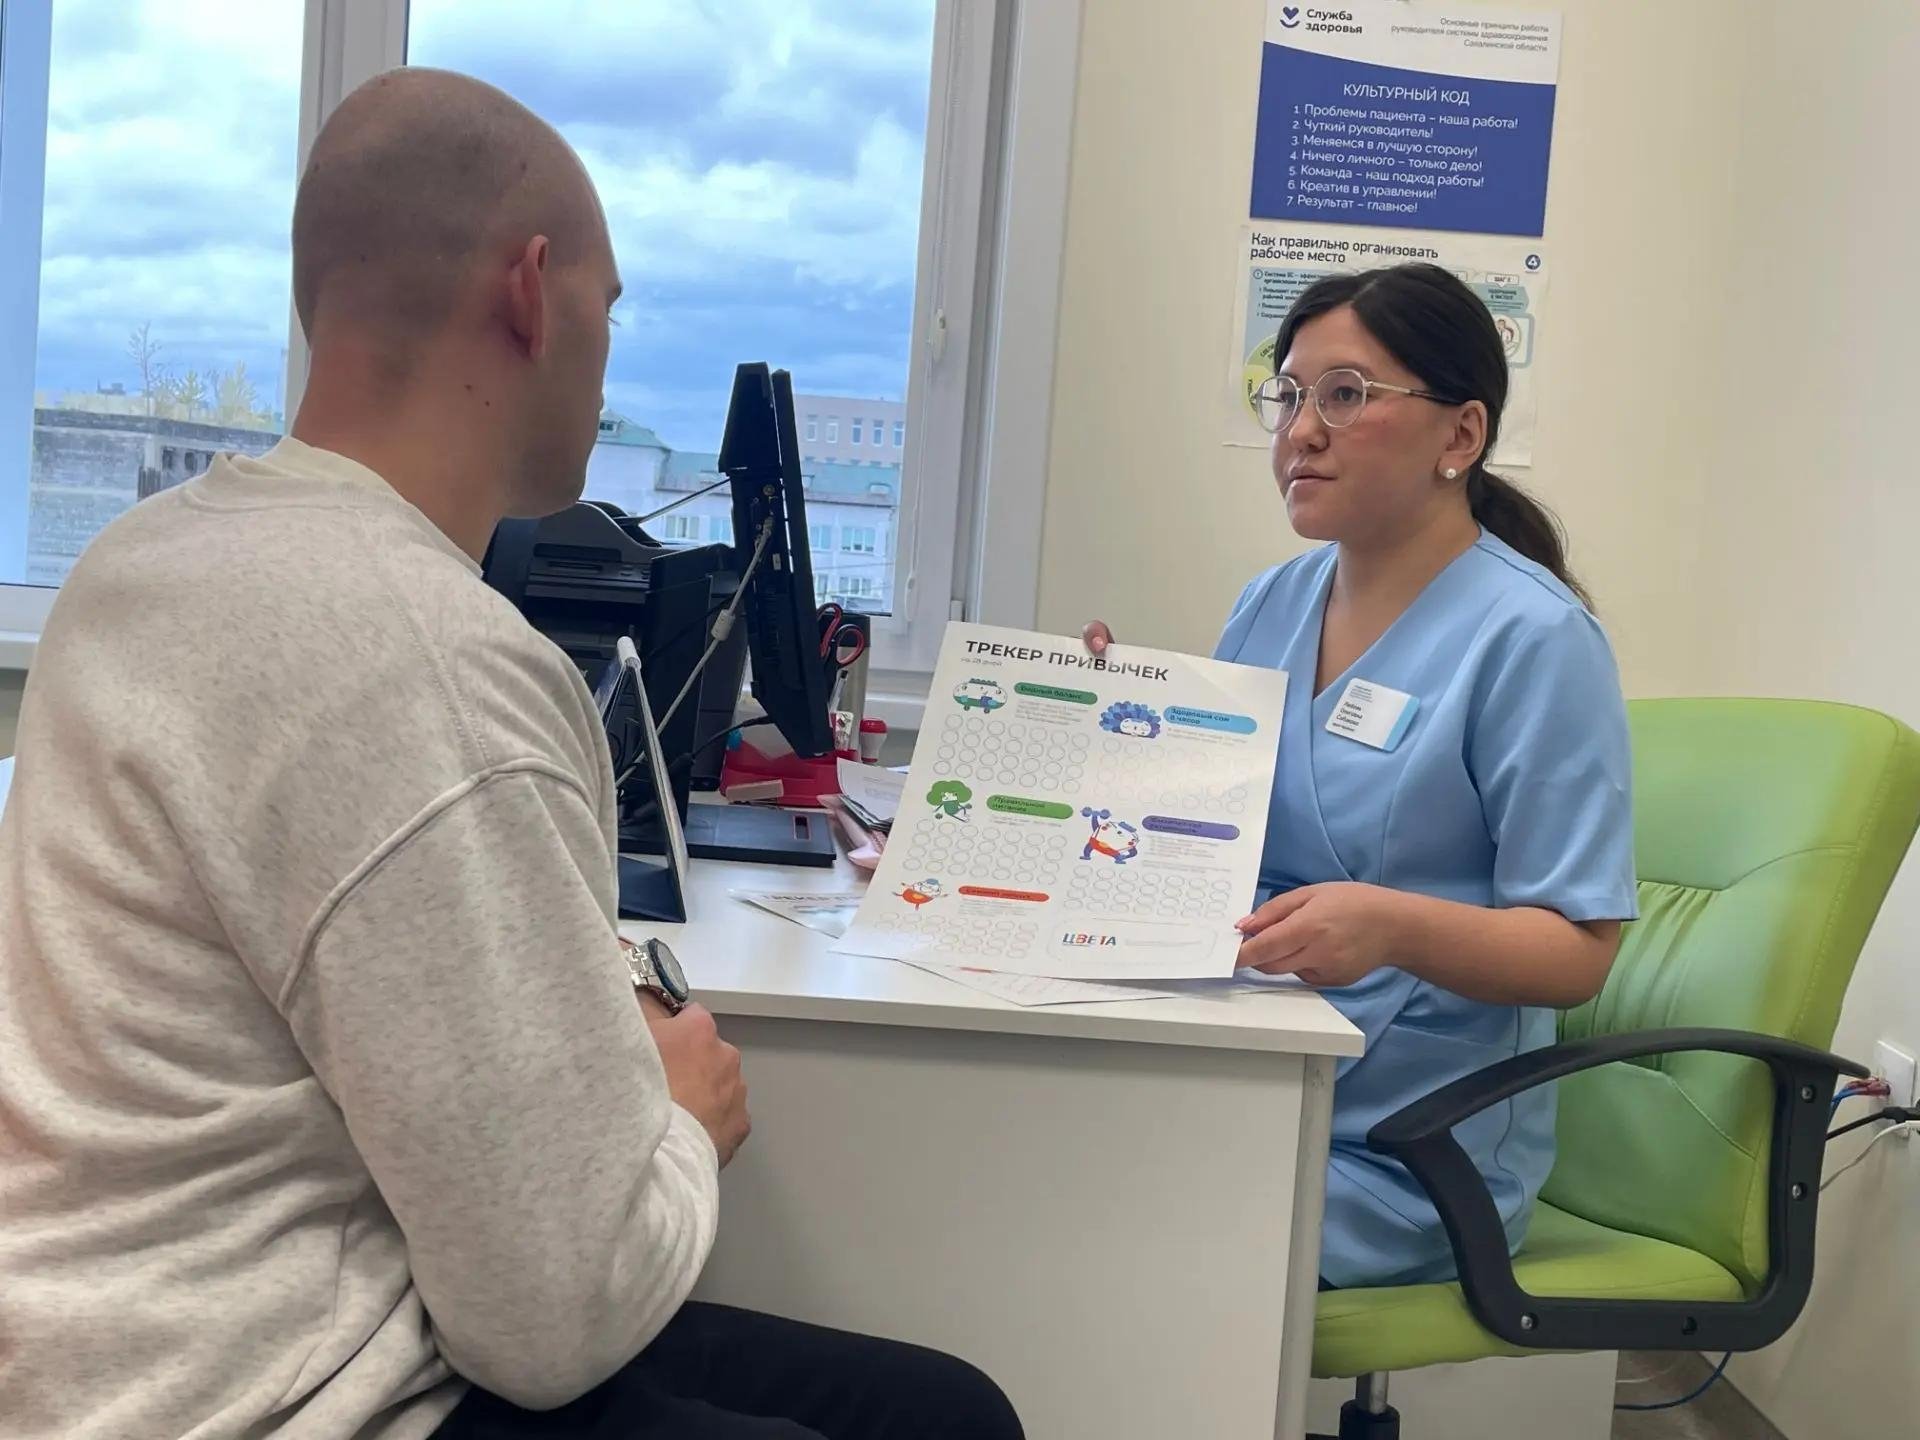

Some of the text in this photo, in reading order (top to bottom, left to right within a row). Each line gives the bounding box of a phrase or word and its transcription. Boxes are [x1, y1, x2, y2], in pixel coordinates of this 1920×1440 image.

[1306, 8, 1353, 21] Служба
[1305, 22, 1362, 34] здоровья
[1440, 18, 1479, 27] Основные
[1521, 24, 1549, 33] работы
[1446, 29, 1478, 37] системы
[1515, 42, 1548, 51] области
[1343, 84, 1470, 106] КУЛЬТУРНЫЙ КОД
[1304, 103, 1367, 120] Проблемы
[1370, 109, 1426, 123] пациента
[1439, 115, 1470, 126] наша
[1472, 117, 1519, 130] работа!
[1304, 119, 1345, 133] Чуткий
[1348, 123, 1434, 139] руководитель!
[1303, 134, 1364, 149] Меняемся
[1367, 140, 1374, 149] в
[1376, 140, 1422, 154] лучшую
[1425, 144, 1478, 158] сторону!
[1302, 150, 1345, 163] Ничего
[1347, 154, 1395, 166] личного
[1409, 158, 1447, 170] только
[1450, 160, 1482, 173] дело!
[1301, 165, 1353, 180] Команда
[1366, 170, 1389, 181] наш
[1393, 172, 1435, 186] подход
[1437, 174, 1484, 188] работы!
[1300, 180, 1350, 194] Креатив
[1353, 185, 1360, 194] в
[1362, 185, 1437, 200] управлении!
[1297, 194, 1354, 210] Результат
[1367, 201, 1418, 214] главное!
[1250, 247, 1346, 263] рабочее место
[1251, 233, 1439, 259] Как правильно организовать
[966, 640, 1169, 681] ТРЕКЕР ПРИВЫЧЕК
